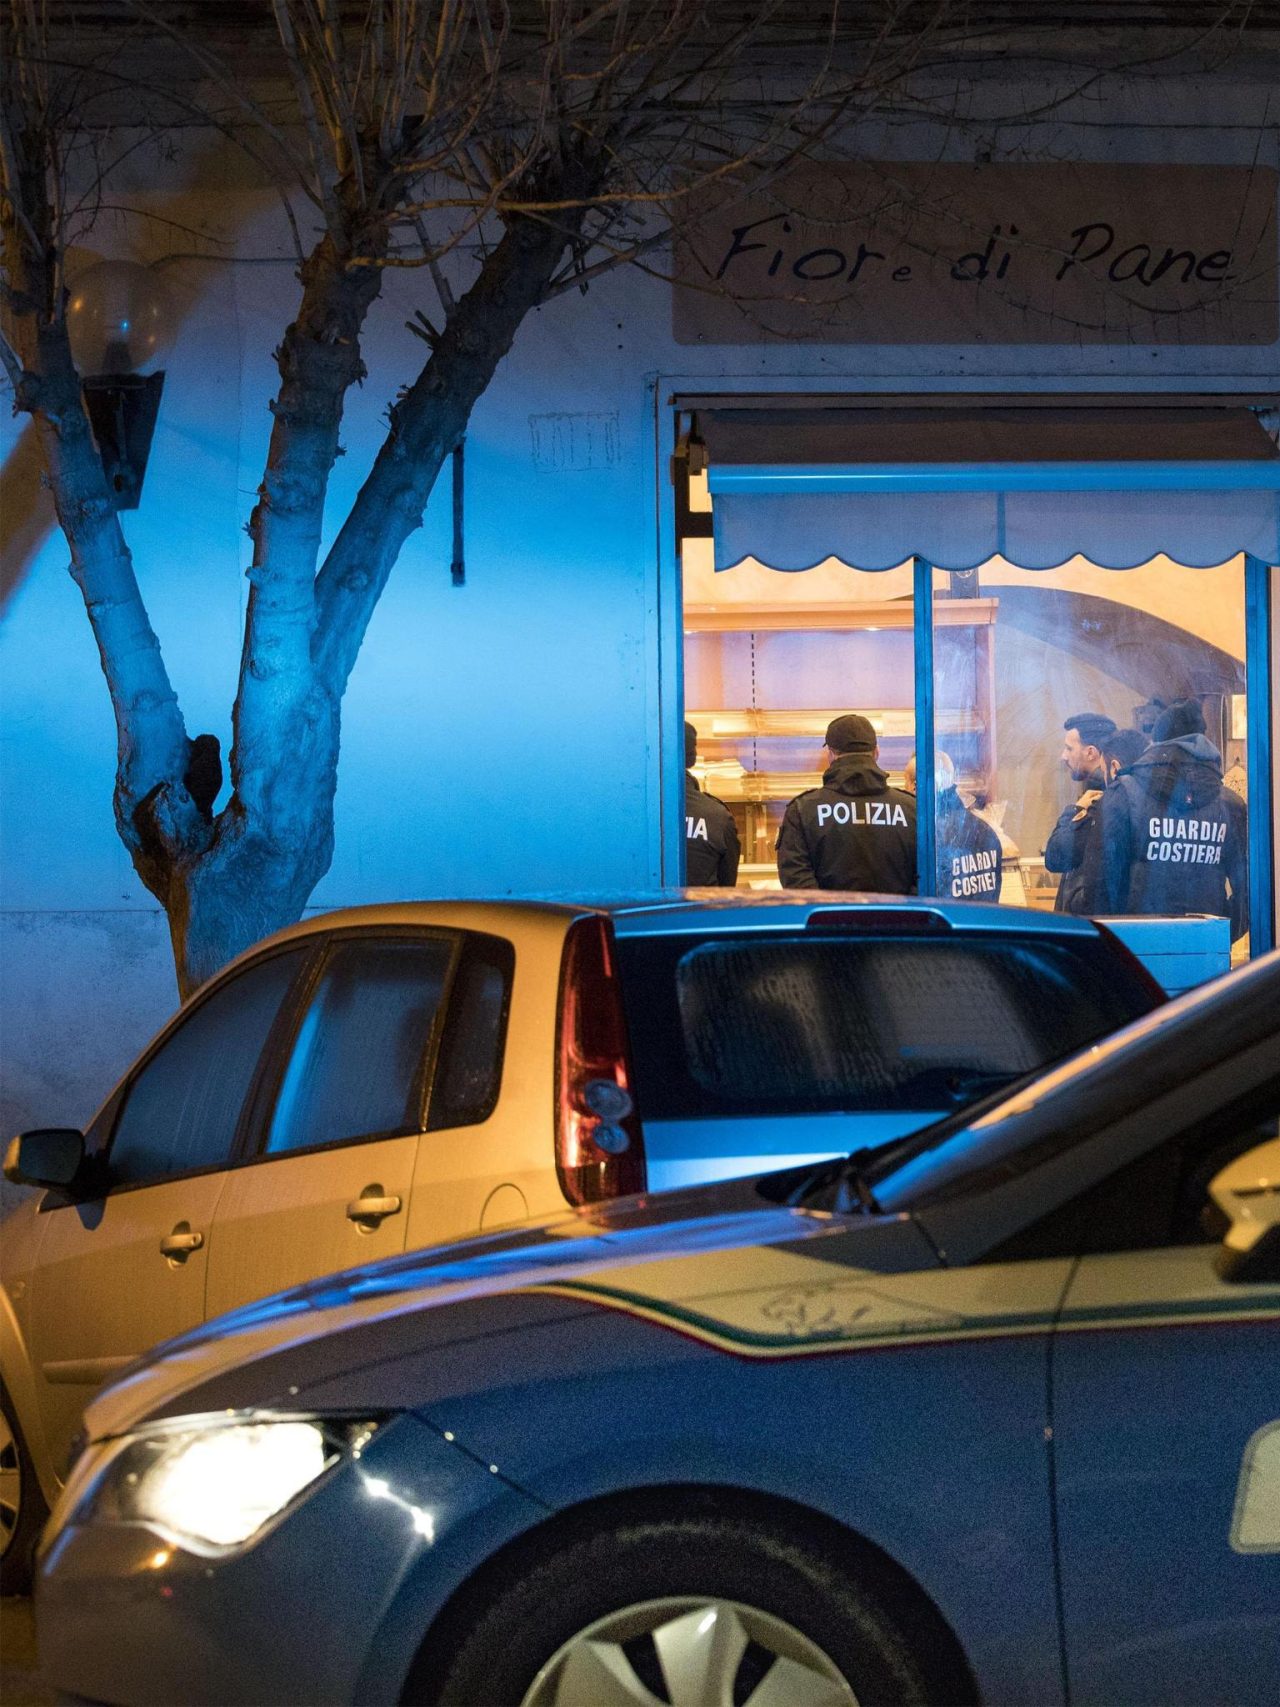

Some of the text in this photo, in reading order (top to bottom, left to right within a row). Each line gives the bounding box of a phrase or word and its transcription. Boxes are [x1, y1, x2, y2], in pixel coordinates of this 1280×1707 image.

[951, 222, 1021, 283] di
[1055, 221, 1239, 288] Pane
[817, 802, 908, 828] POLIZIA
[685, 816, 708, 841] IA
[1149, 817, 1227, 843] GUARDIA
[1146, 840, 1222, 864] COSTIERA
